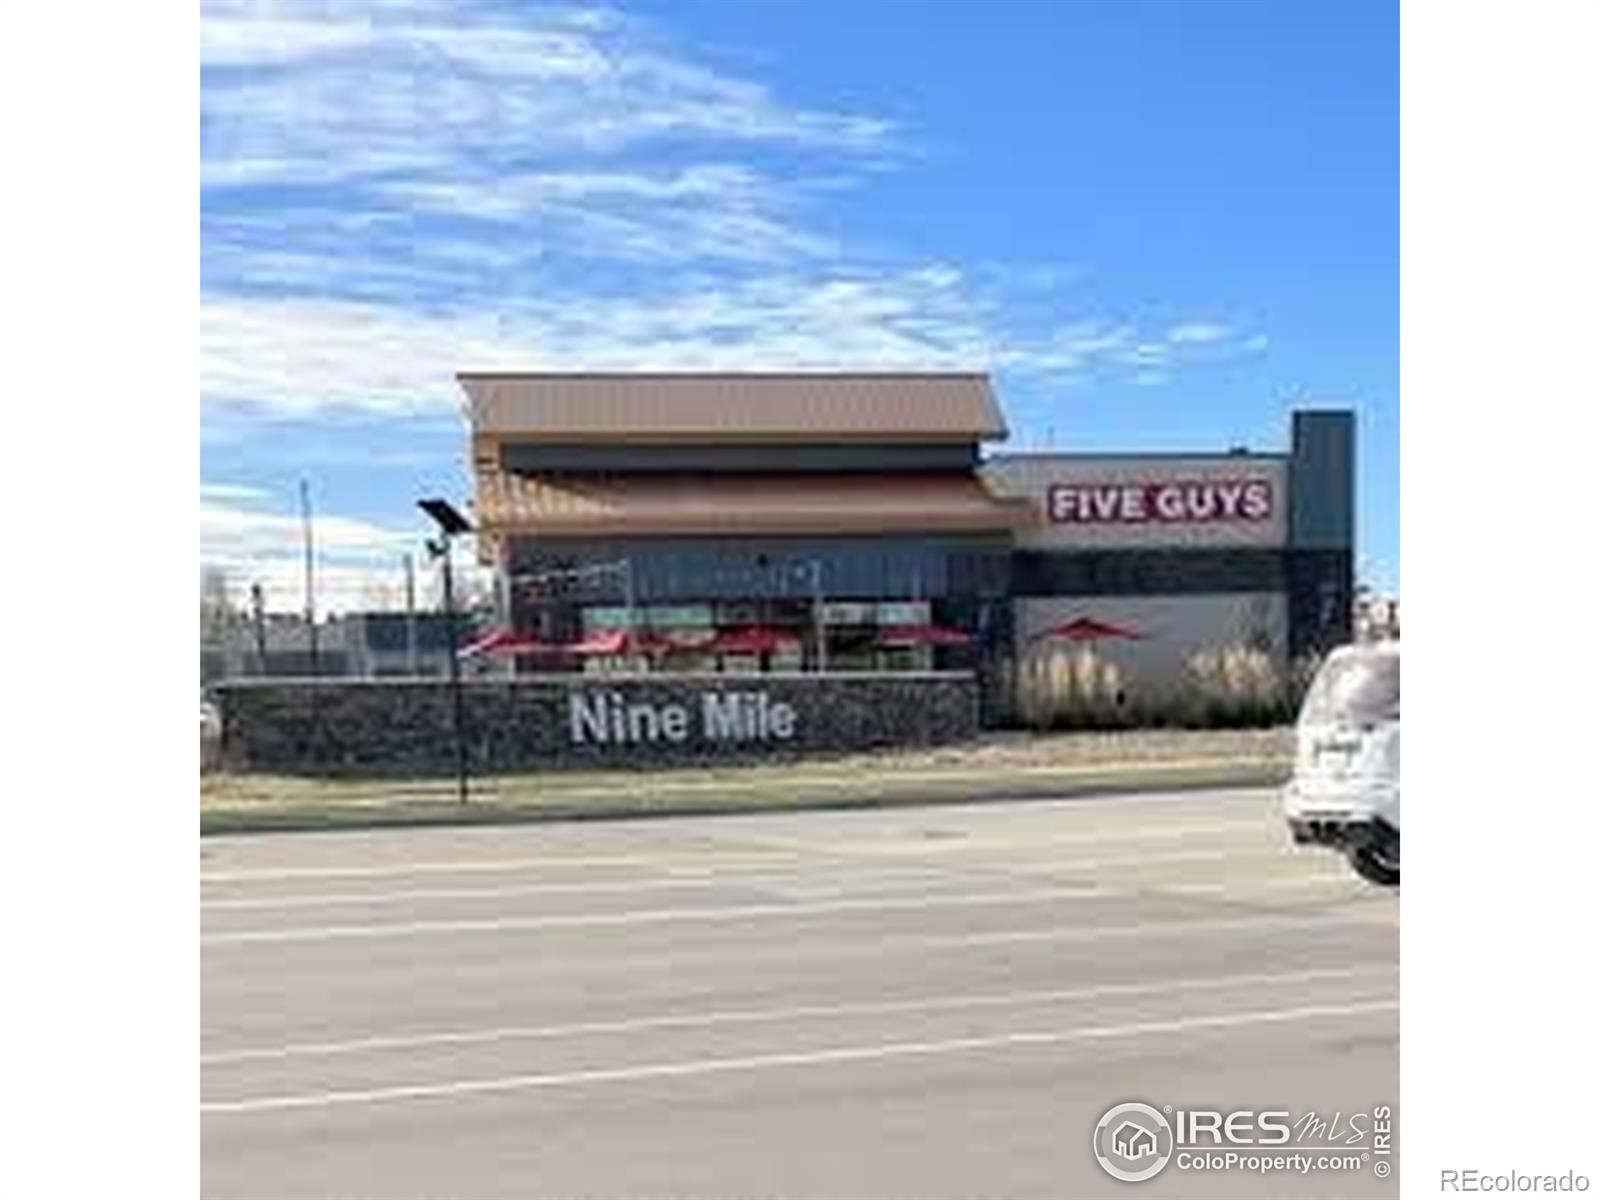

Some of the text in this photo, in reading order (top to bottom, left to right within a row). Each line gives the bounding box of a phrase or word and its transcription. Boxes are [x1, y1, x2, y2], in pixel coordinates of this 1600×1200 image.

[1052, 483, 1270, 520] FIVE GUYS
[569, 691, 797, 743] Nine Mile
